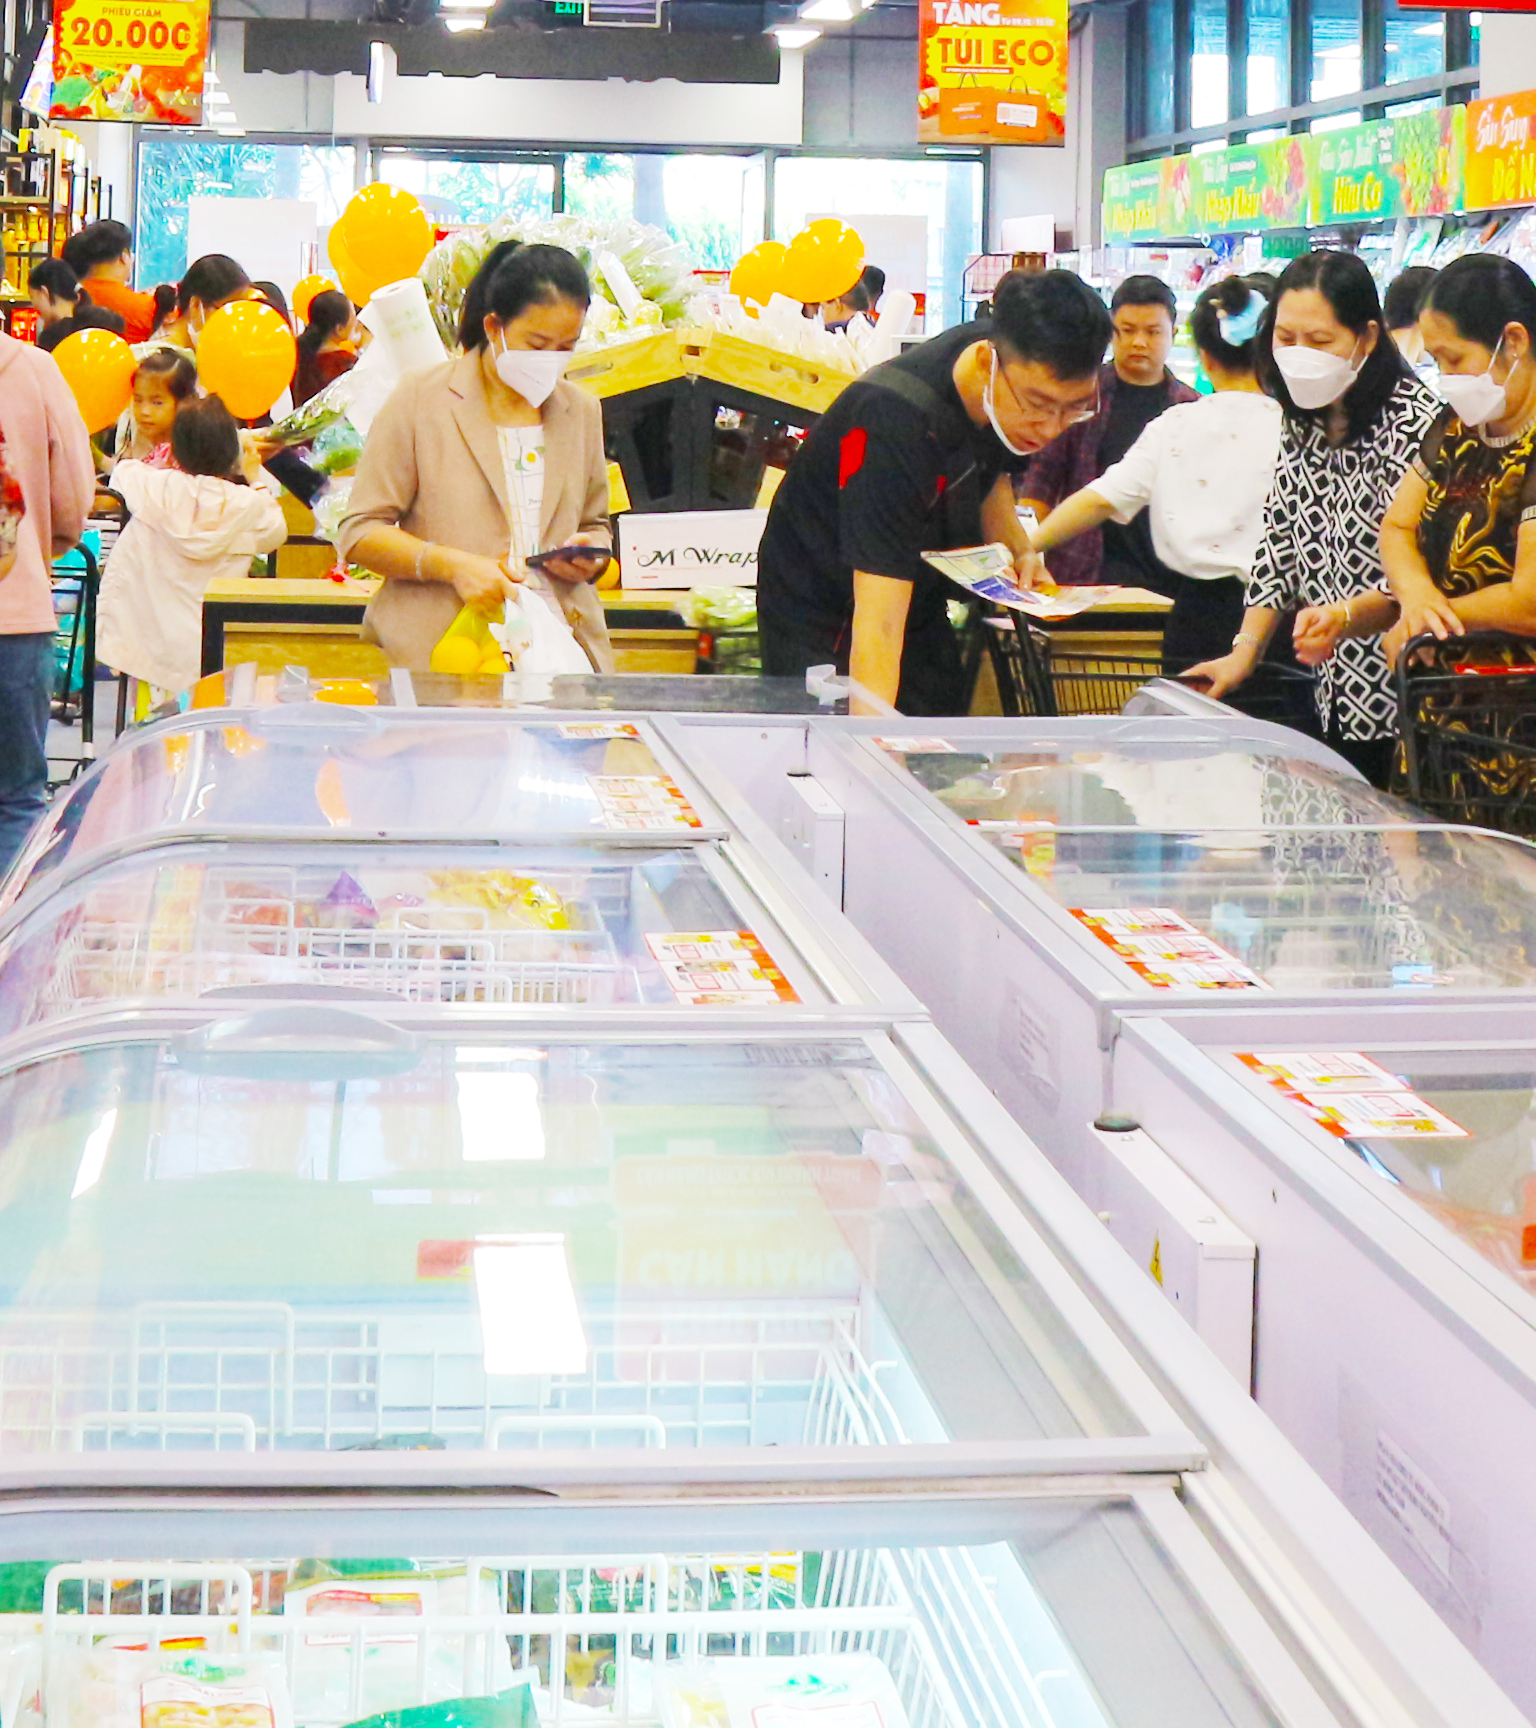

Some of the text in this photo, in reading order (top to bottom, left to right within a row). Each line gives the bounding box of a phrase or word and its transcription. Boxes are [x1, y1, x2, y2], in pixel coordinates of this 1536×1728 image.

[937, 31, 1055, 66] TÚI ECO
[637, 548, 676, 567] M
